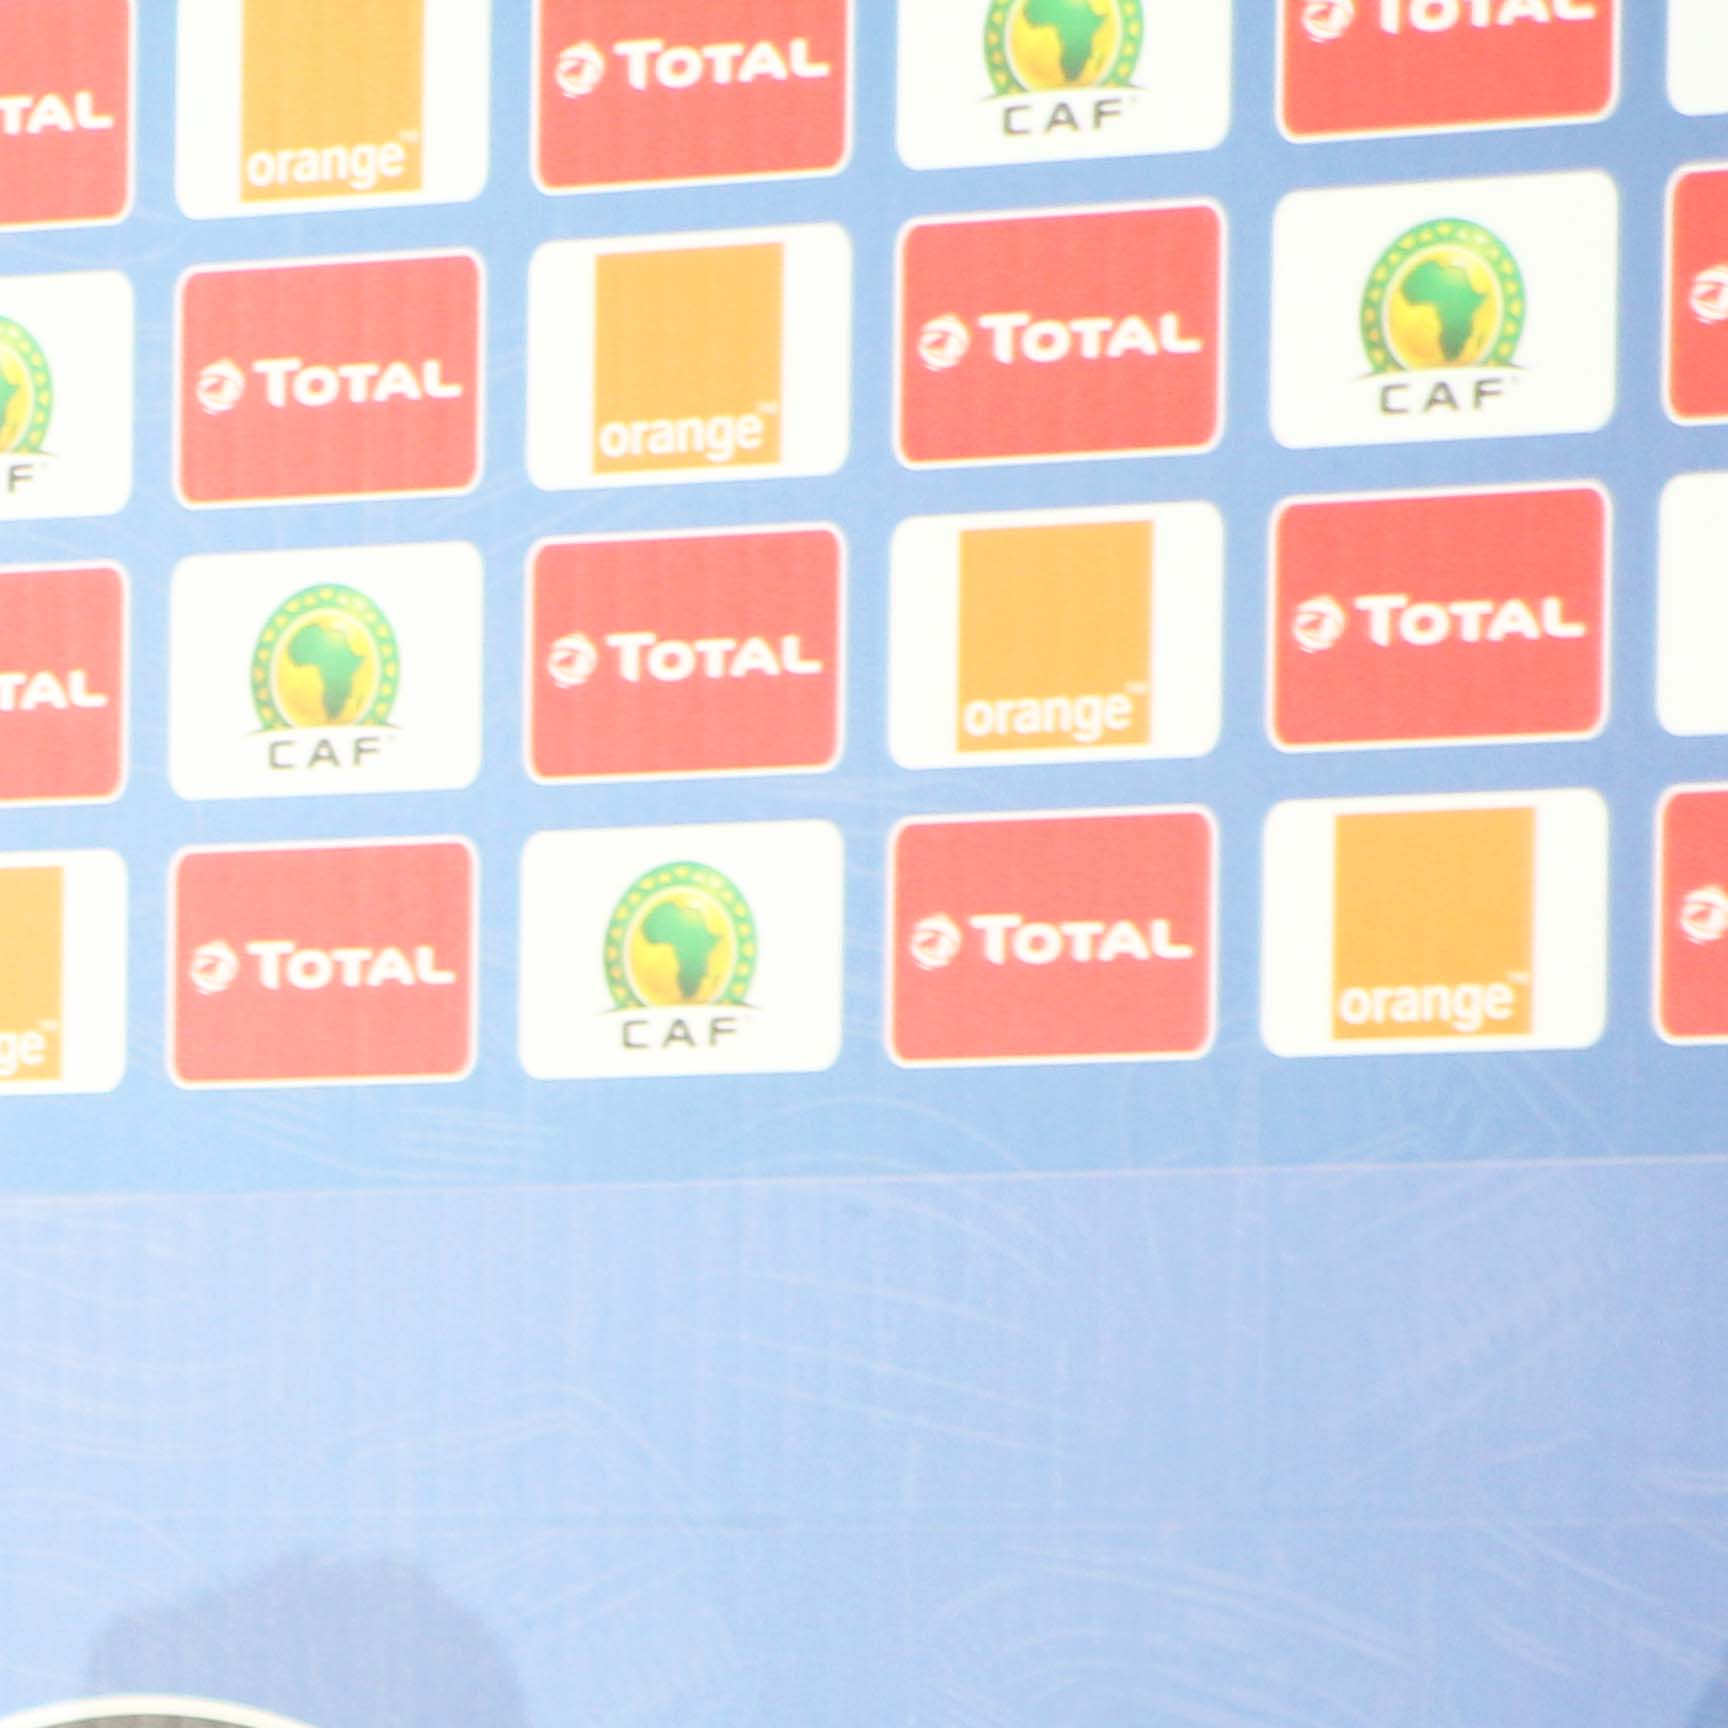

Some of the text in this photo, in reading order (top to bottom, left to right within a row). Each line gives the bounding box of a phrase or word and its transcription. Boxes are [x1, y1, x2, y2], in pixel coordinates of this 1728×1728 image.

[613, 37, 830, 90] TOTAL
[1002, 99, 1121, 138] CAF
[246, 137, 405, 190] orange
[978, 311, 1203, 364] TOTAL
[252, 357, 463, 407] TOTAL
[1379, 378, 1501, 416] CAF
[598, 411, 764, 461] orange
[1354, 593, 1586, 647] TOTAL
[605, 631, 823, 682] TOTAL
[963, 691, 1132, 743] orange
[268, 737, 379, 771] CAF
[969, 913, 1194, 965] TOTAL
[245, 940, 457, 990] TOTAL
[1338, 980, 1514, 1032] orange
[621, 1017, 736, 1051] CAF
